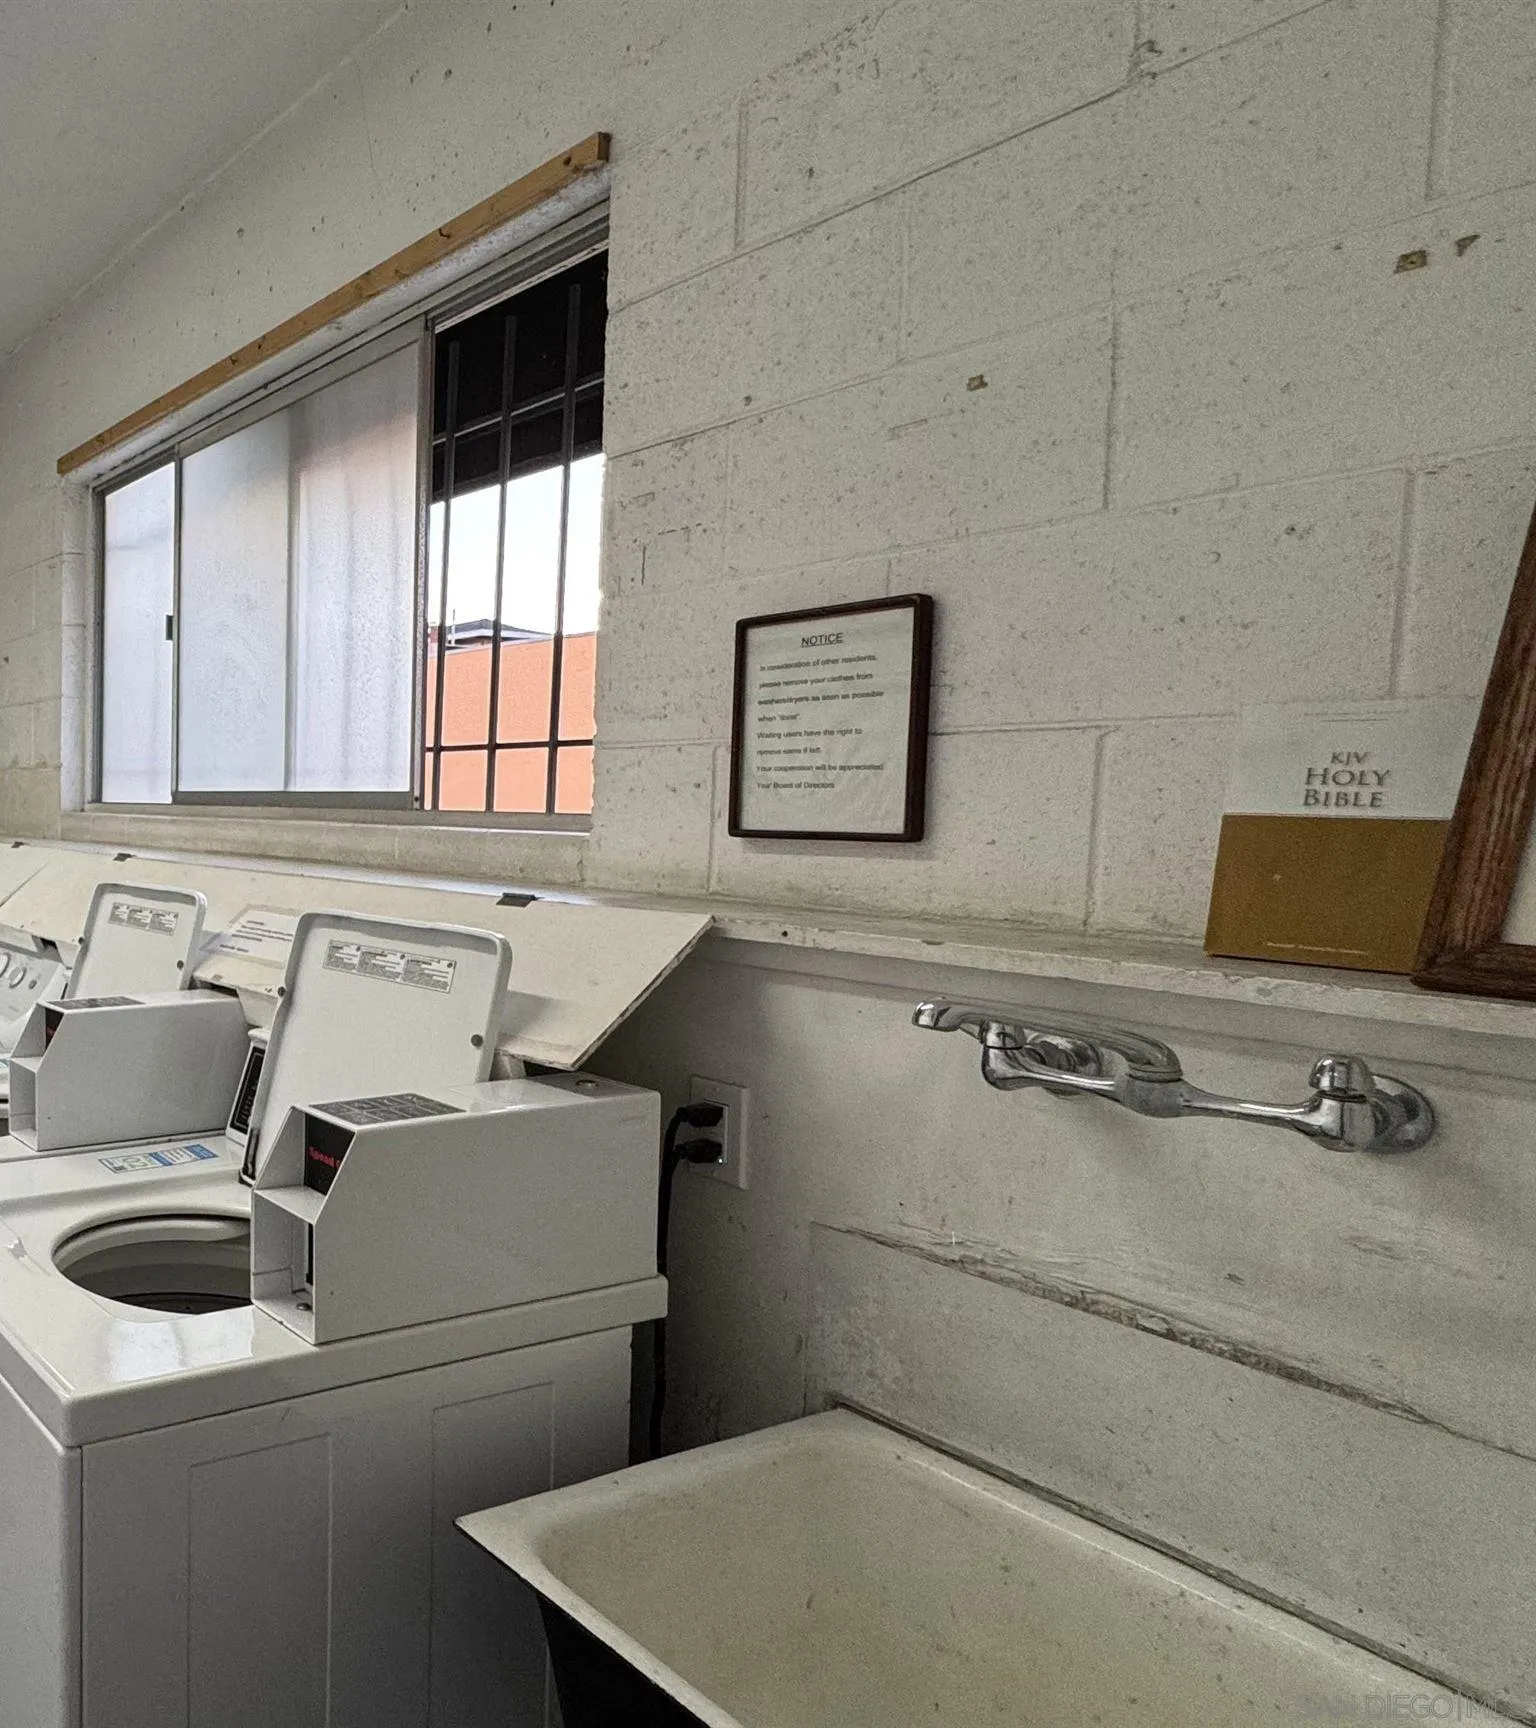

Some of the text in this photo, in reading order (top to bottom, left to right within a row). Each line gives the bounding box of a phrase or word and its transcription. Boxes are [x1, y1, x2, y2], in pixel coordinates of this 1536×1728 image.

[800, 632, 844, 648] NOTICE
[767, 661, 811, 671] consideration
[812, 659, 820, 667] of
[821, 657, 840, 666] other
[810, 677, 826, 685] your
[855, 672, 874, 681] from
[851, 690, 885, 699] possible
[836, 728, 853, 737] right
[773, 765, 814, 773] cooperation
[814, 763, 826, 771] will
[827, 763, 837, 771] be
[1304, 767, 1391, 786] HOLY
[1303, 788, 1384, 808] BIBLE
